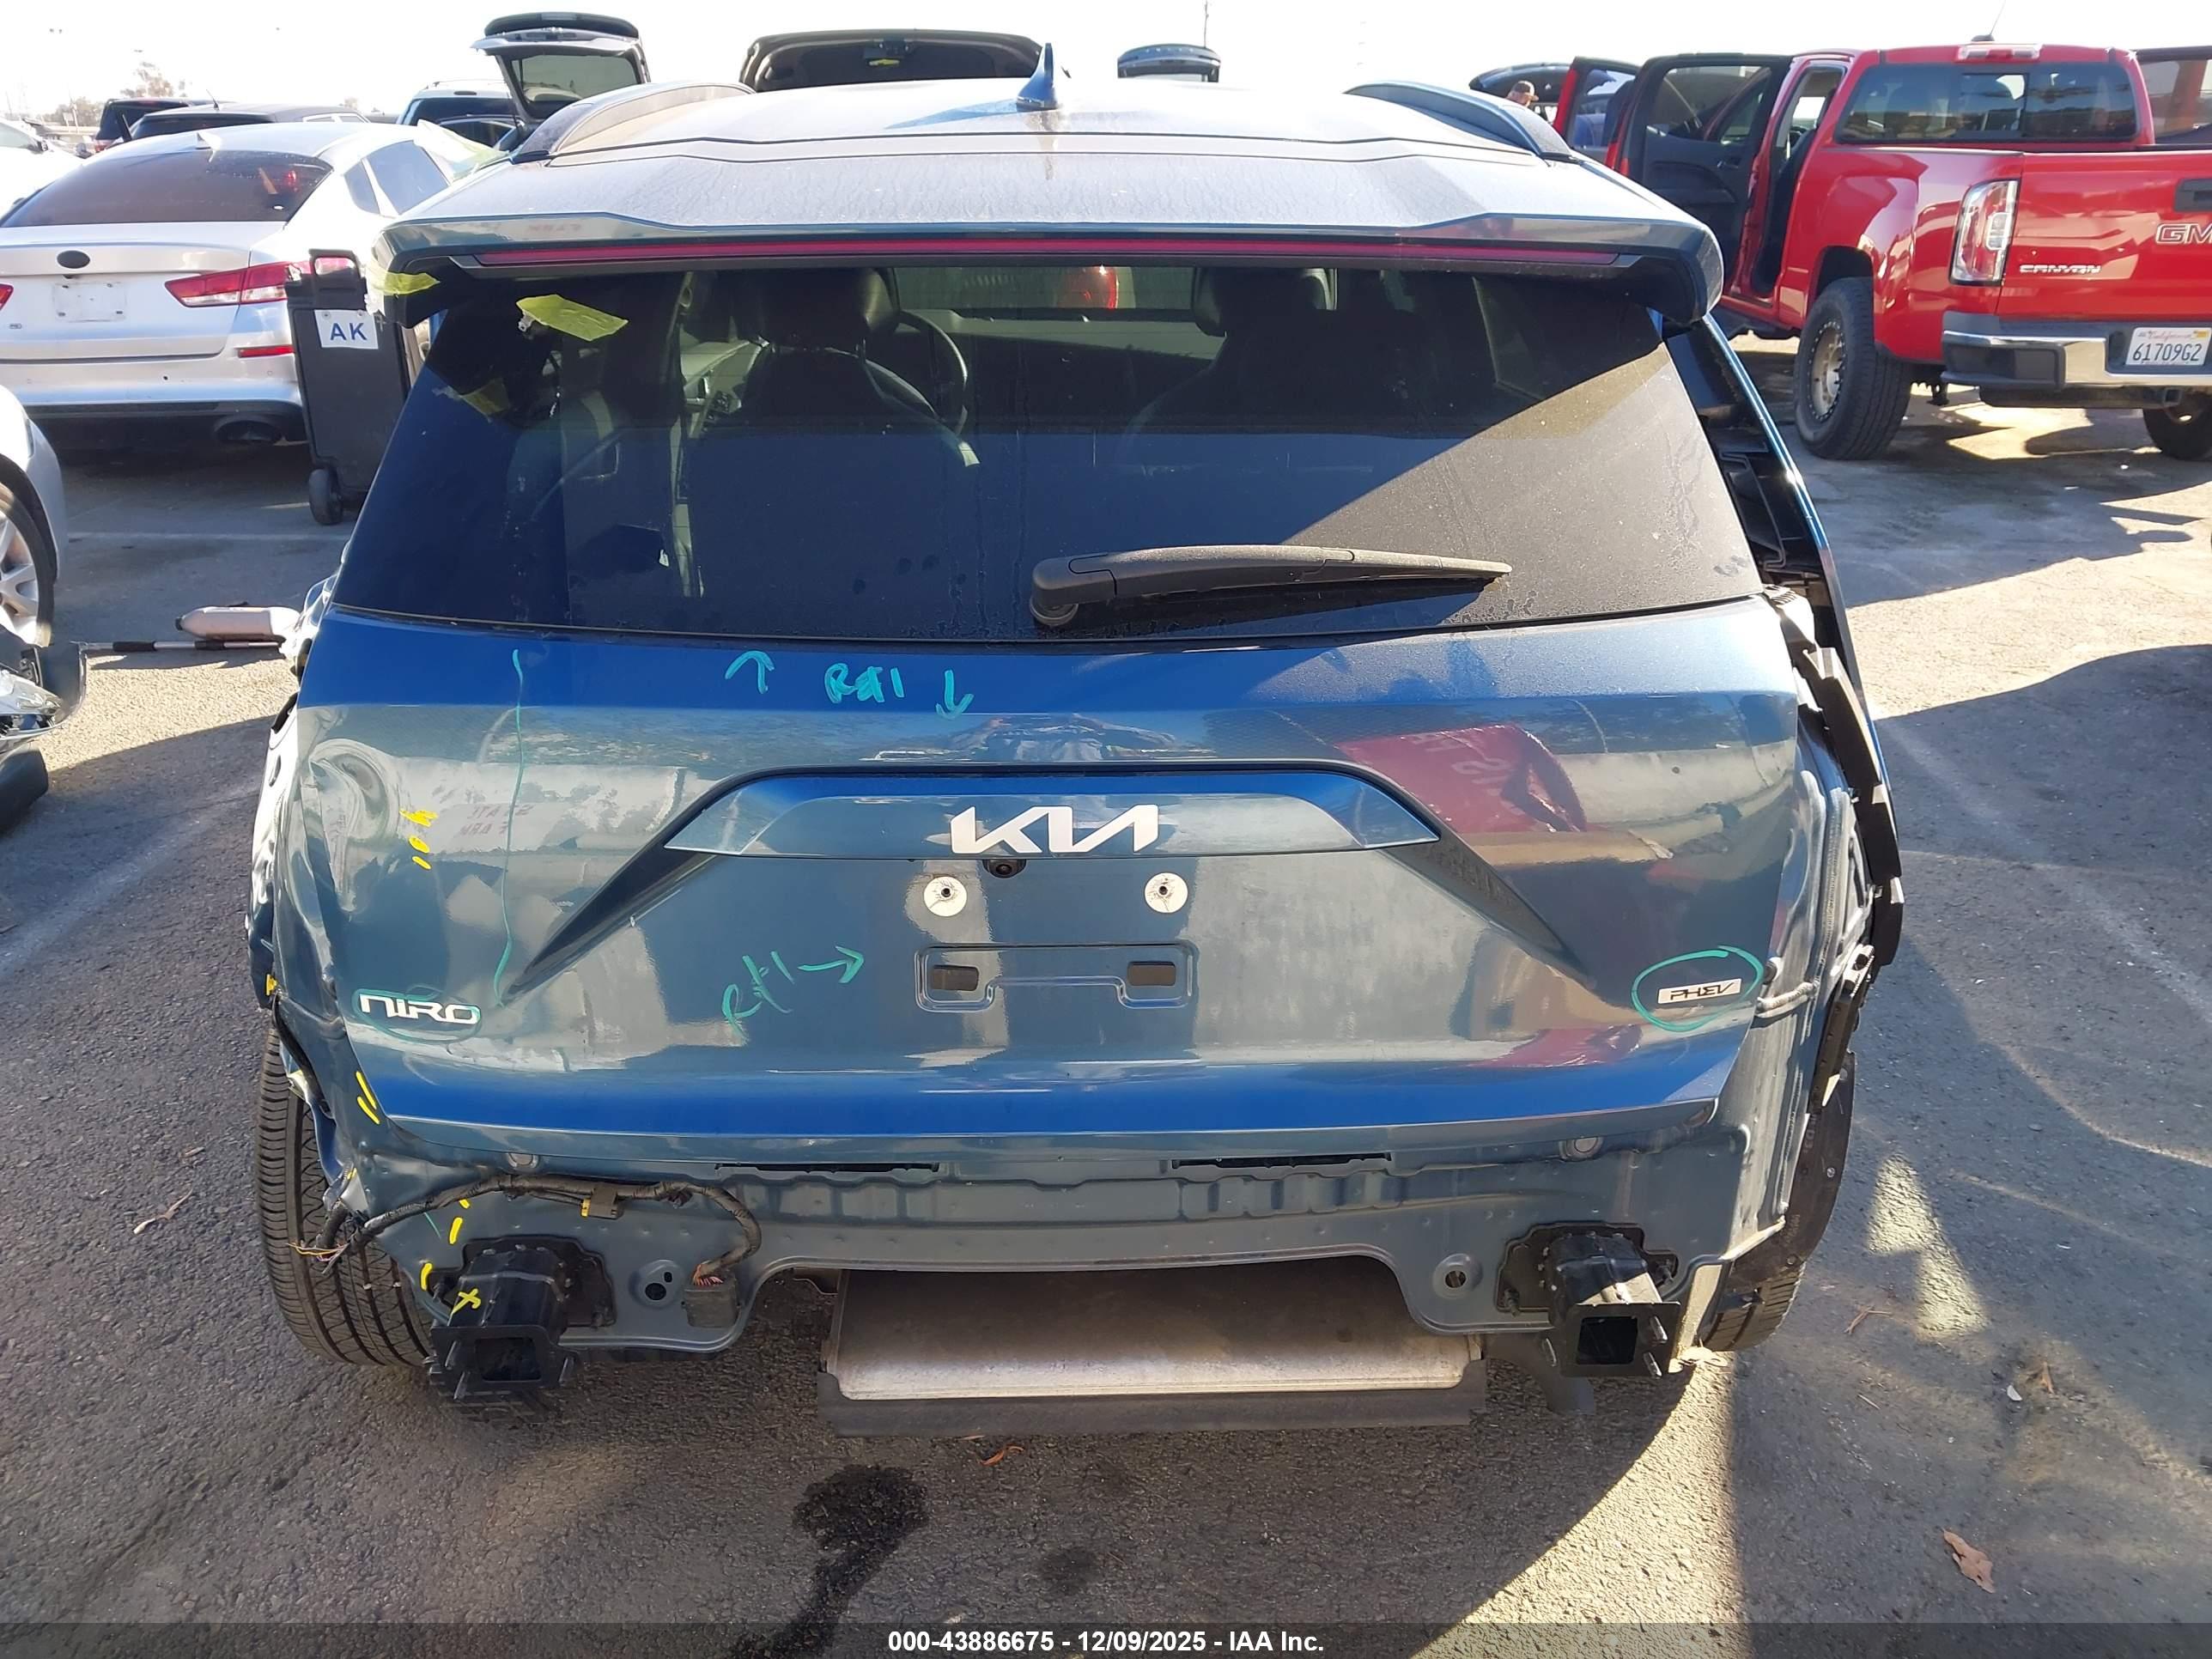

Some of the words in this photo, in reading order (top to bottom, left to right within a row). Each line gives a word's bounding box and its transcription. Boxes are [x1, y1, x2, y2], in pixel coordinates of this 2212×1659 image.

[2019, 264, 2101, 274] CANYON
[330, 322, 368, 341] AK
[2132, 343, 2203, 362] 61709G2
[951, 804, 1158, 854] KIA
[1670, 981, 1735, 1000] PHEV
[359, 994, 481, 1024] NIRO
